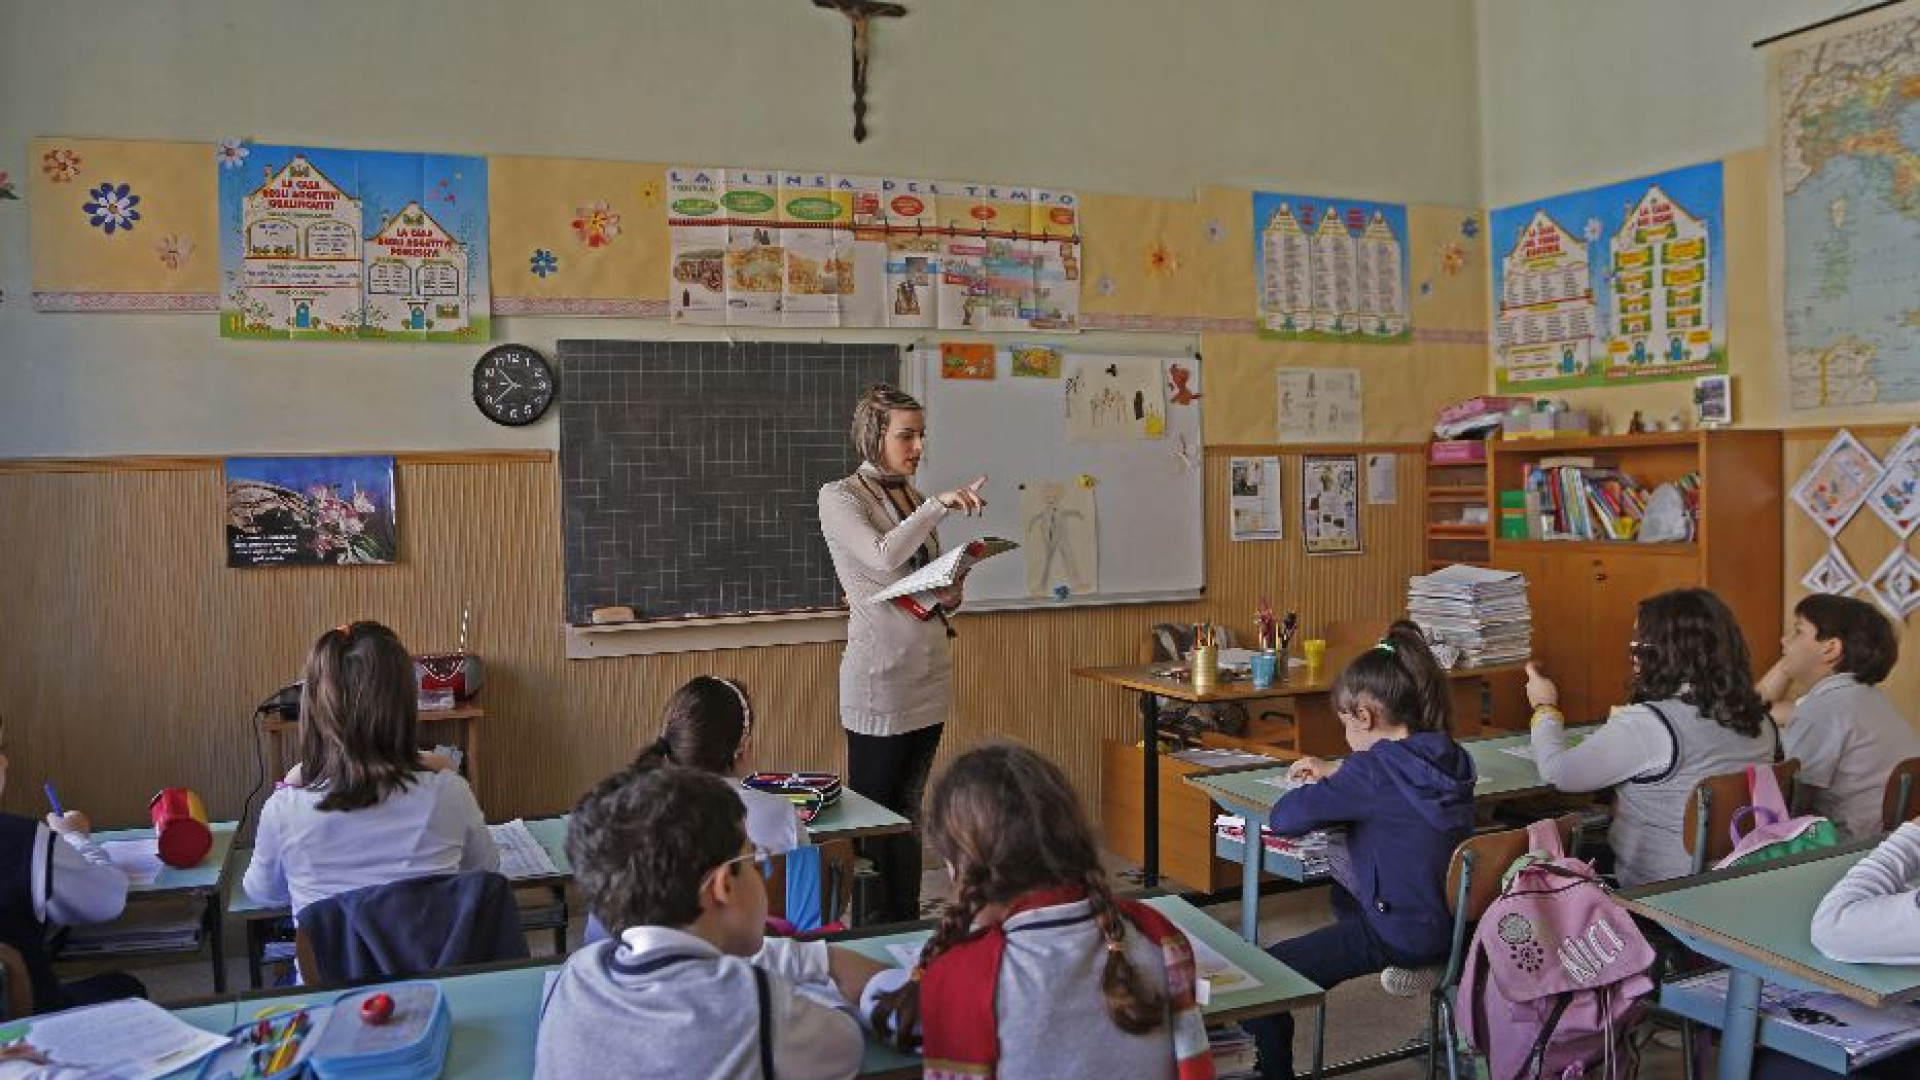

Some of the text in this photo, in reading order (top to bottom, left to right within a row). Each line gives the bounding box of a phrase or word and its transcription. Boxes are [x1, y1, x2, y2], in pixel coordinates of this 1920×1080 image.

[670, 171, 1074, 204] LA LINEA DEL TEMPO
[494, 357, 505, 367] 11
[506, 353, 520, 363] 12
[525, 357, 530, 367] 1
[509, 408, 518, 419] 6
[524, 405, 532, 415] 5
